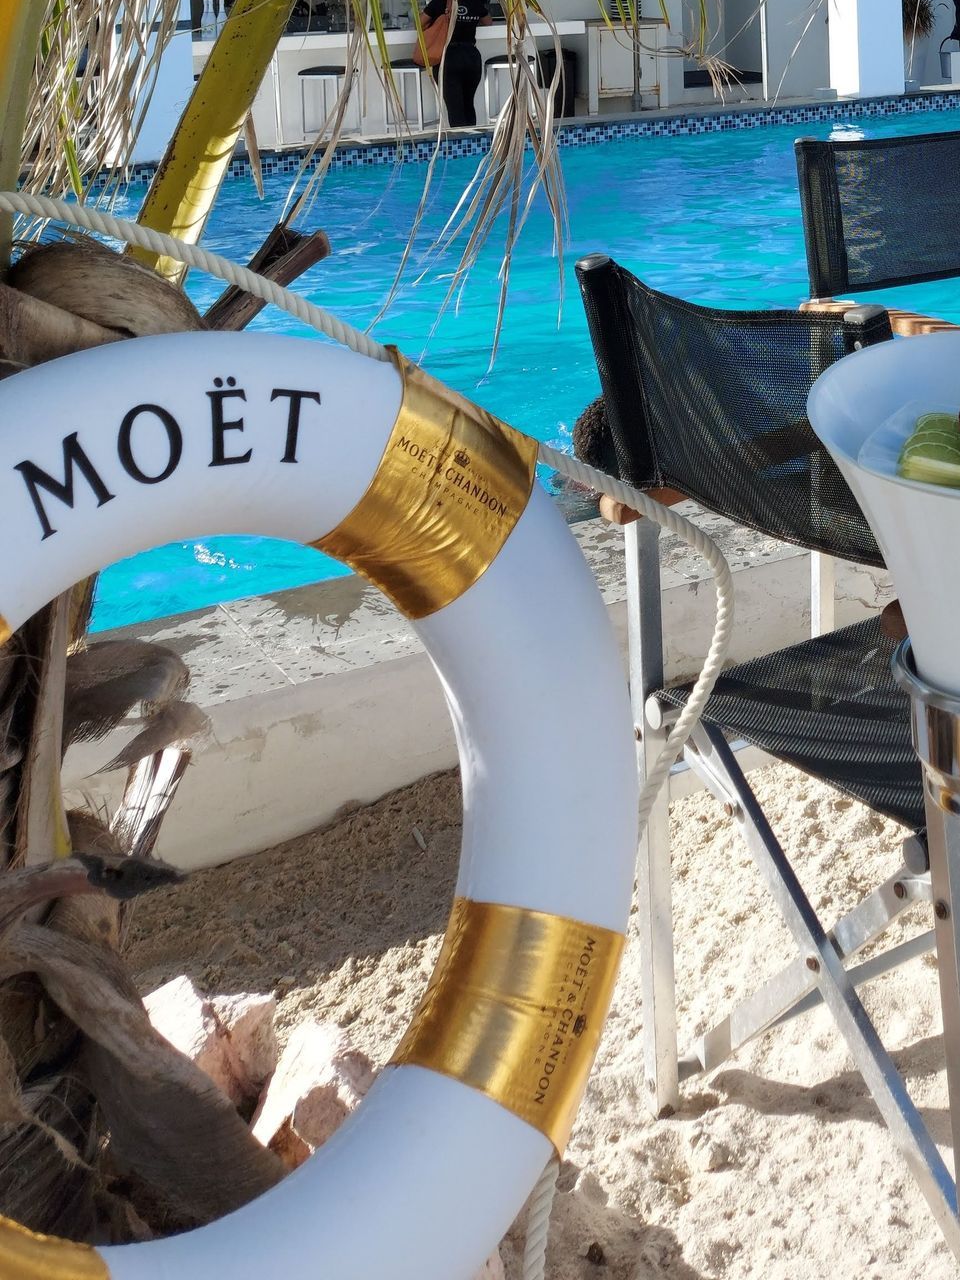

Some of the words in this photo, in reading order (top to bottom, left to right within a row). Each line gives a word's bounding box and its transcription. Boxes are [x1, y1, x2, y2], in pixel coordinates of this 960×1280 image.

[13, 376, 321, 541] MOËT
[397, 436, 436, 468] MOËT
[436, 463, 443, 475] &
[445, 467, 508, 518] CHANDON
[411, 466, 480, 515] CHAMPAGNE
[566, 992, 577, 1003] &
[533, 1008, 574, 1105] CHANDON
